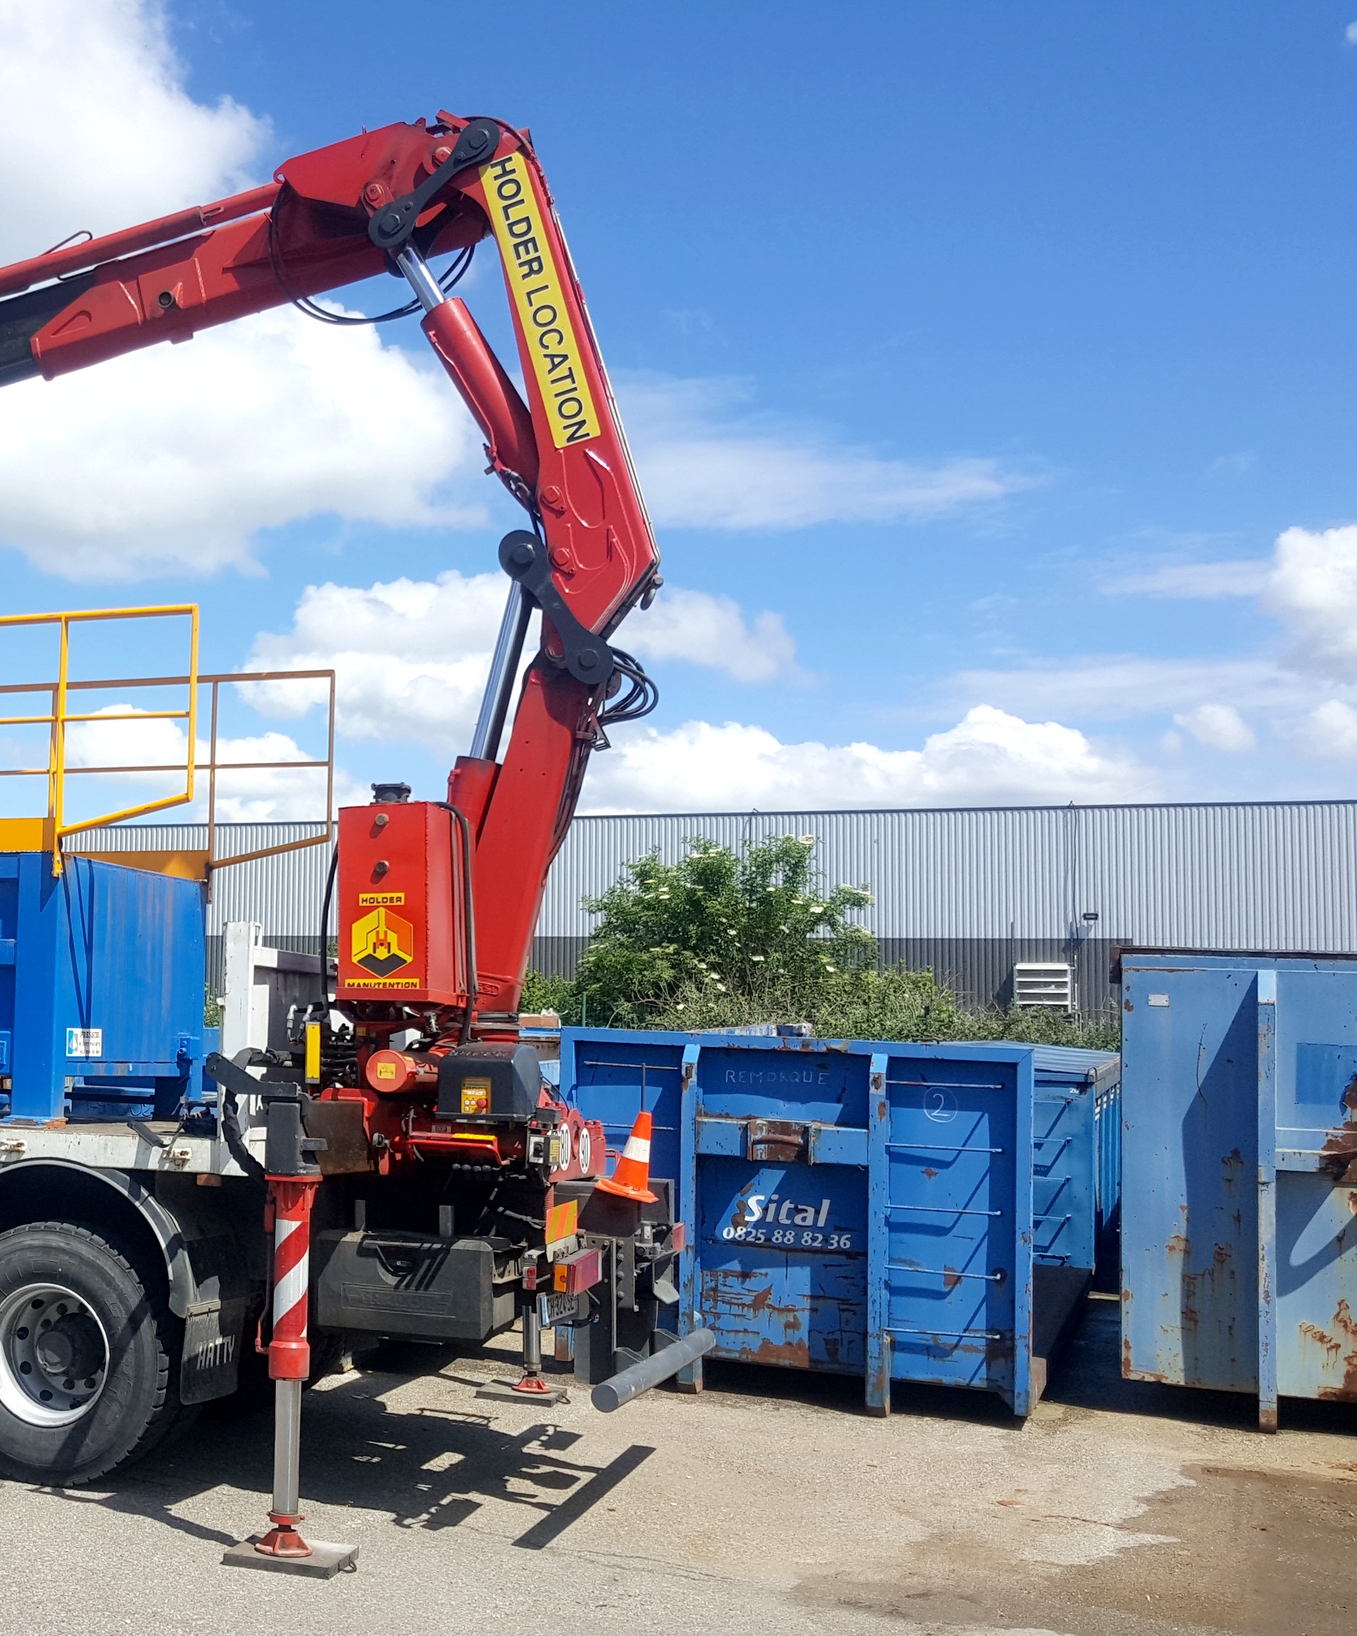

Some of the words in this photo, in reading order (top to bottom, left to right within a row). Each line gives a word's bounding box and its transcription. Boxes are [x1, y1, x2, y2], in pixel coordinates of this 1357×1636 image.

[490, 156, 545, 281] HOLDER
[526, 285, 591, 444] LOCATION
[361, 896, 403, 905] HOLDER
[725, 1069, 831, 1086] REMORQUE
[930, 1093, 951, 1118] 2
[744, 1194, 831, 1228] Sital
[722, 1226, 766, 1243] 0825
[772, 1230, 795, 1245] 88
[800, 1232, 823, 1247] 82
[827, 1234, 852, 1249] 36
